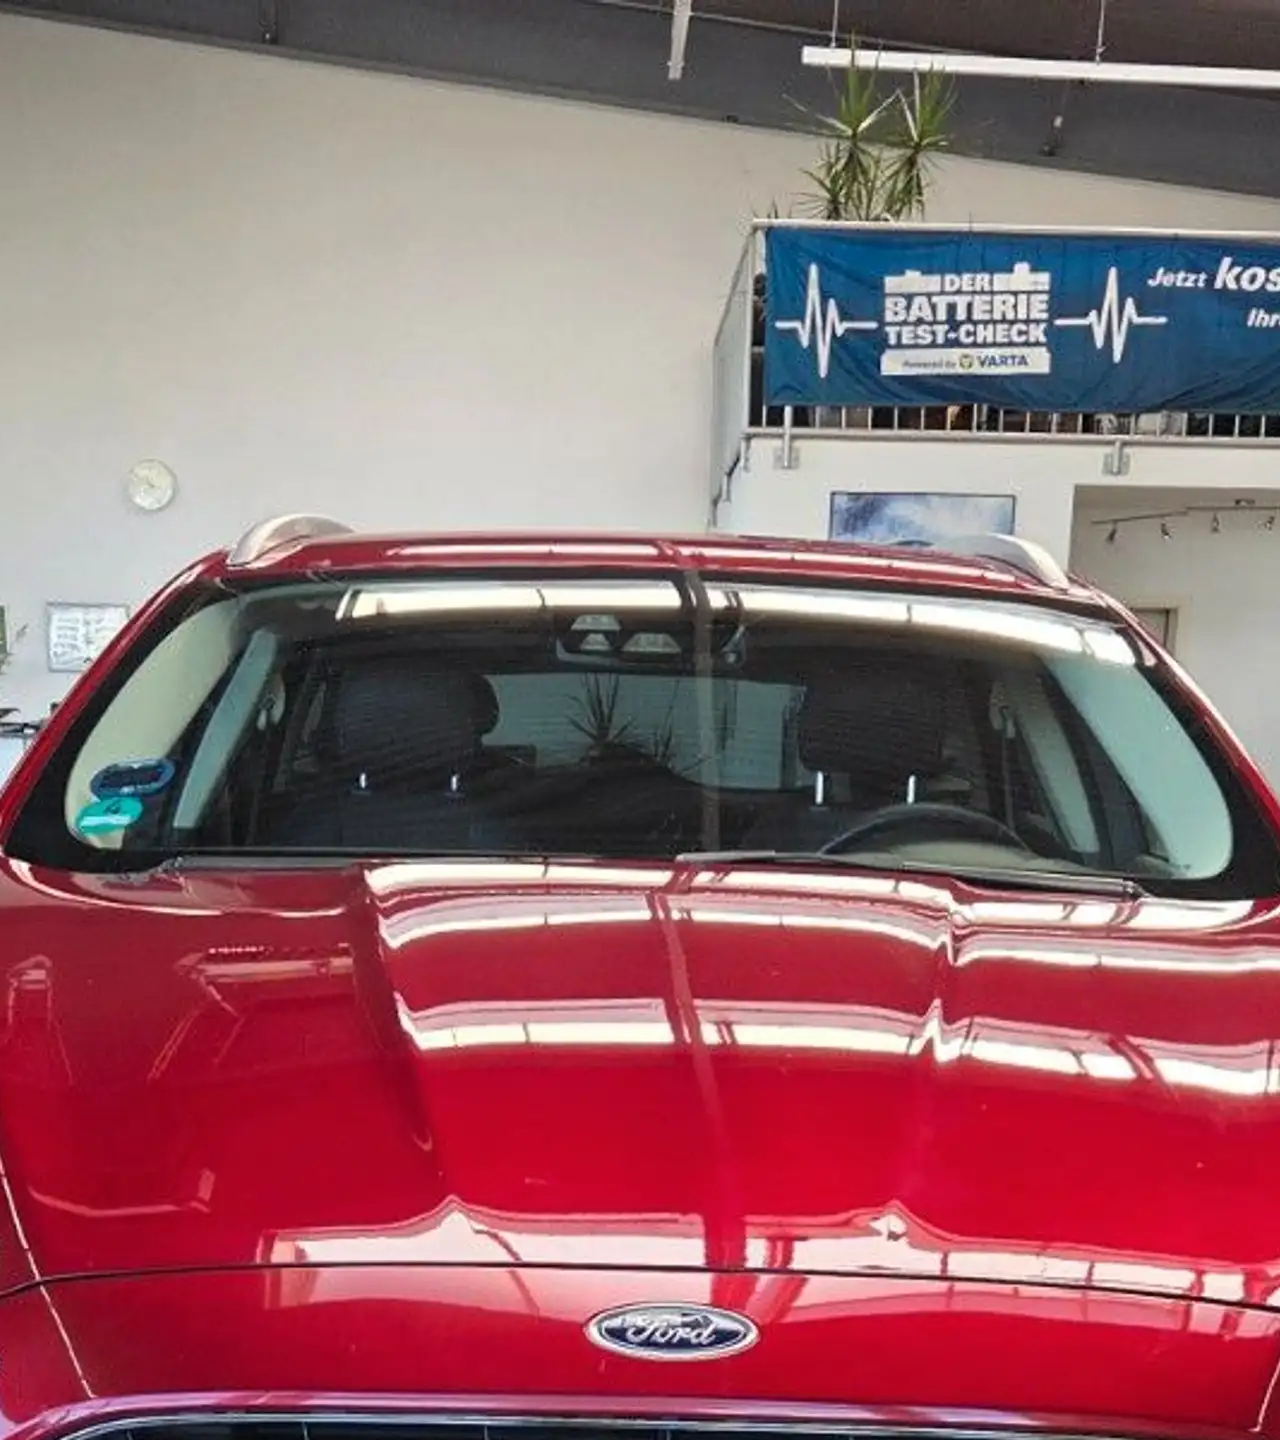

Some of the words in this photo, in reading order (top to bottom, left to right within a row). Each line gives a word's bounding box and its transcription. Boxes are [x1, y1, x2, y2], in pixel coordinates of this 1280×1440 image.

[943, 272, 991, 292] DER
[1147, 267, 1206, 288] Jetzt
[885, 293, 1050, 322] BATTERIE
[885, 323, 1047, 345] TEST-CHECK
[977, 354, 1029, 368] VARTA
[624, 1312, 717, 1345] Ford
